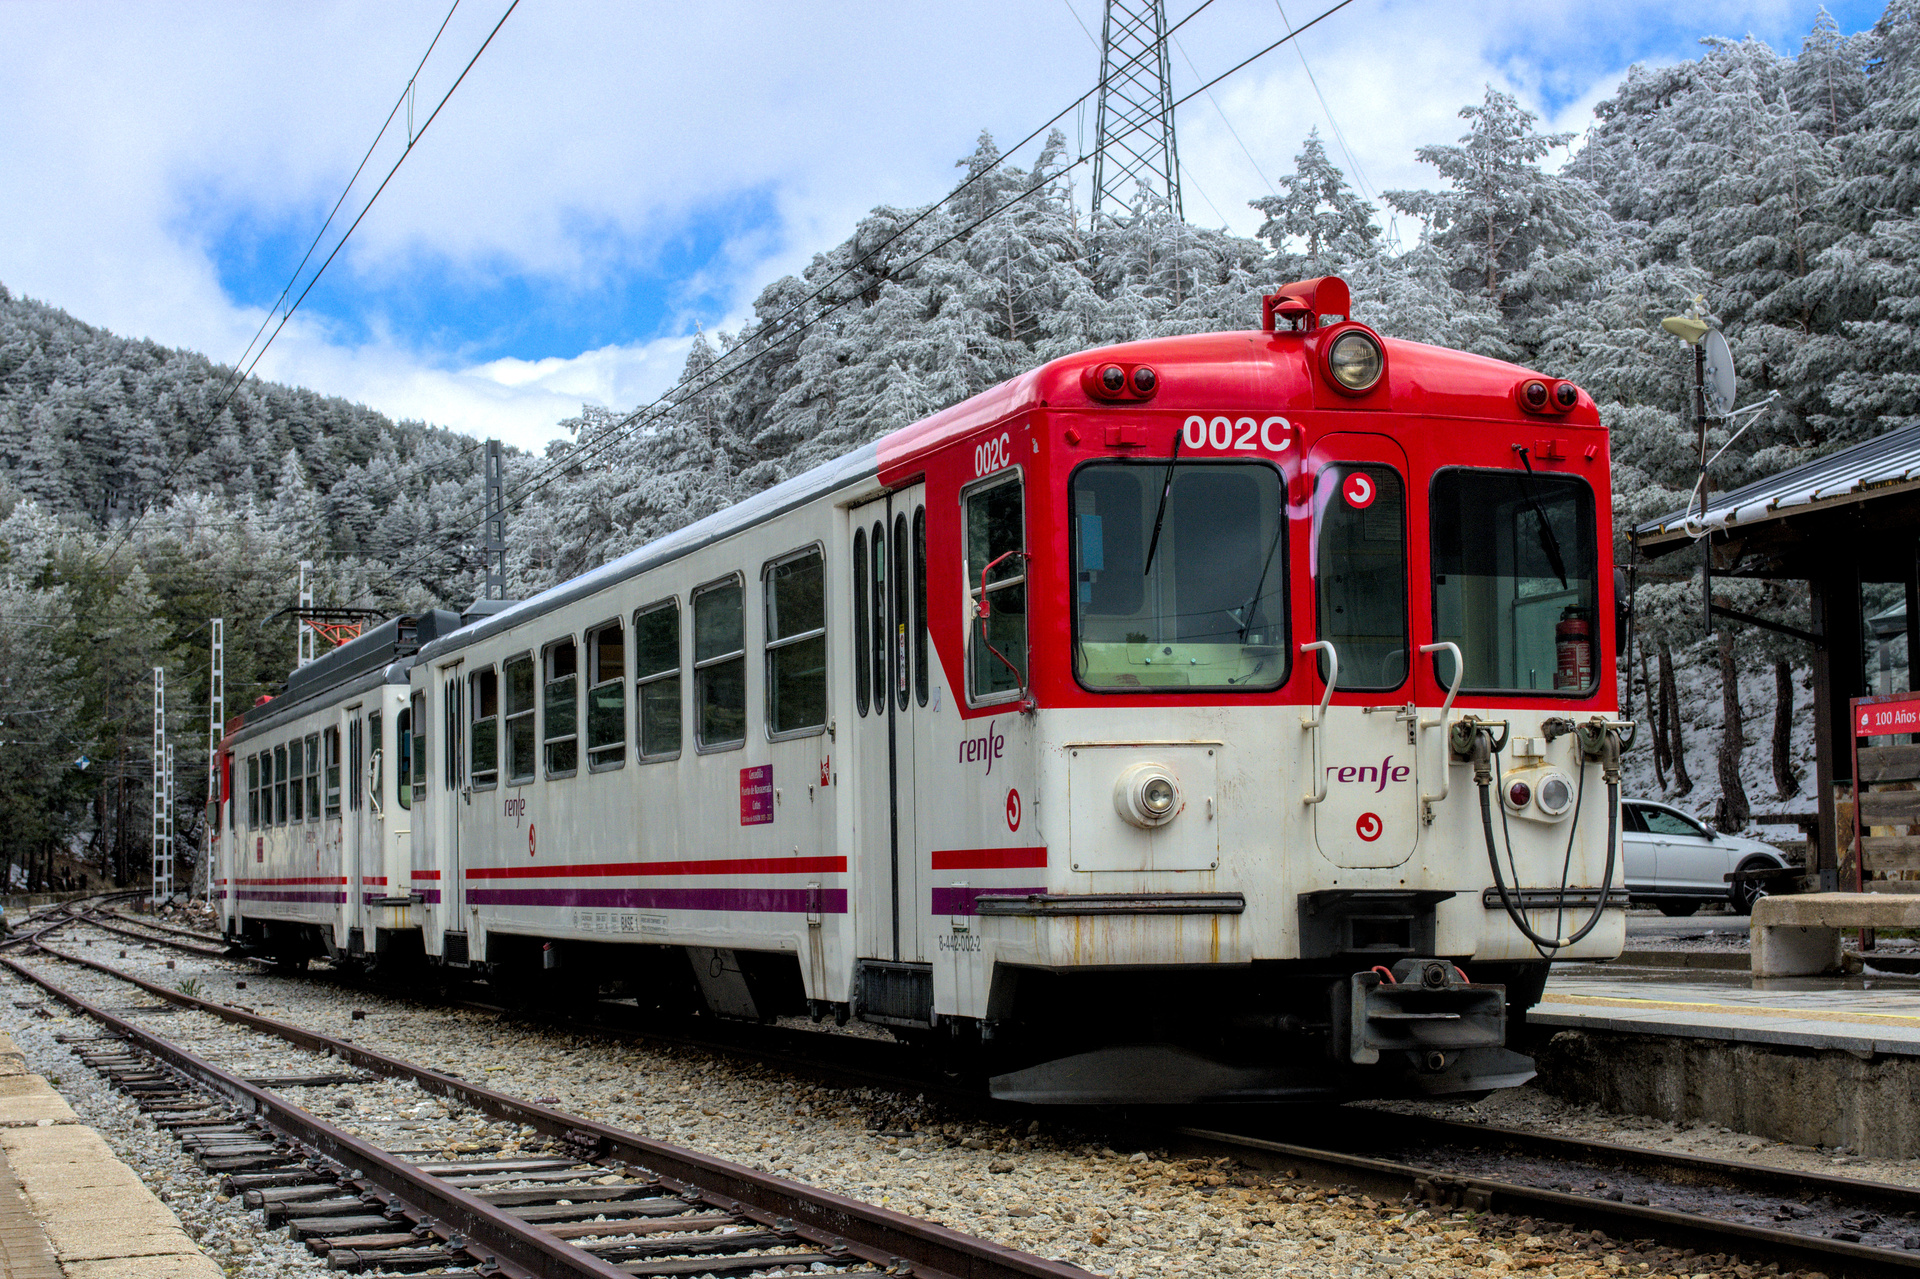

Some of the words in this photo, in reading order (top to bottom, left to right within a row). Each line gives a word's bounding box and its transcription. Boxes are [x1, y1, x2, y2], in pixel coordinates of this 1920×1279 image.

[1183, 415, 1291, 452] 002C
[975, 432, 1010, 477] 002C
[1875, 711, 1893, 726] 100
[1894, 709, 1917, 724] Años
[959, 719, 1004, 776] renfe
[1326, 754, 1410, 794] renfe
[939, 934, 981, 952] 8-442-002-2
